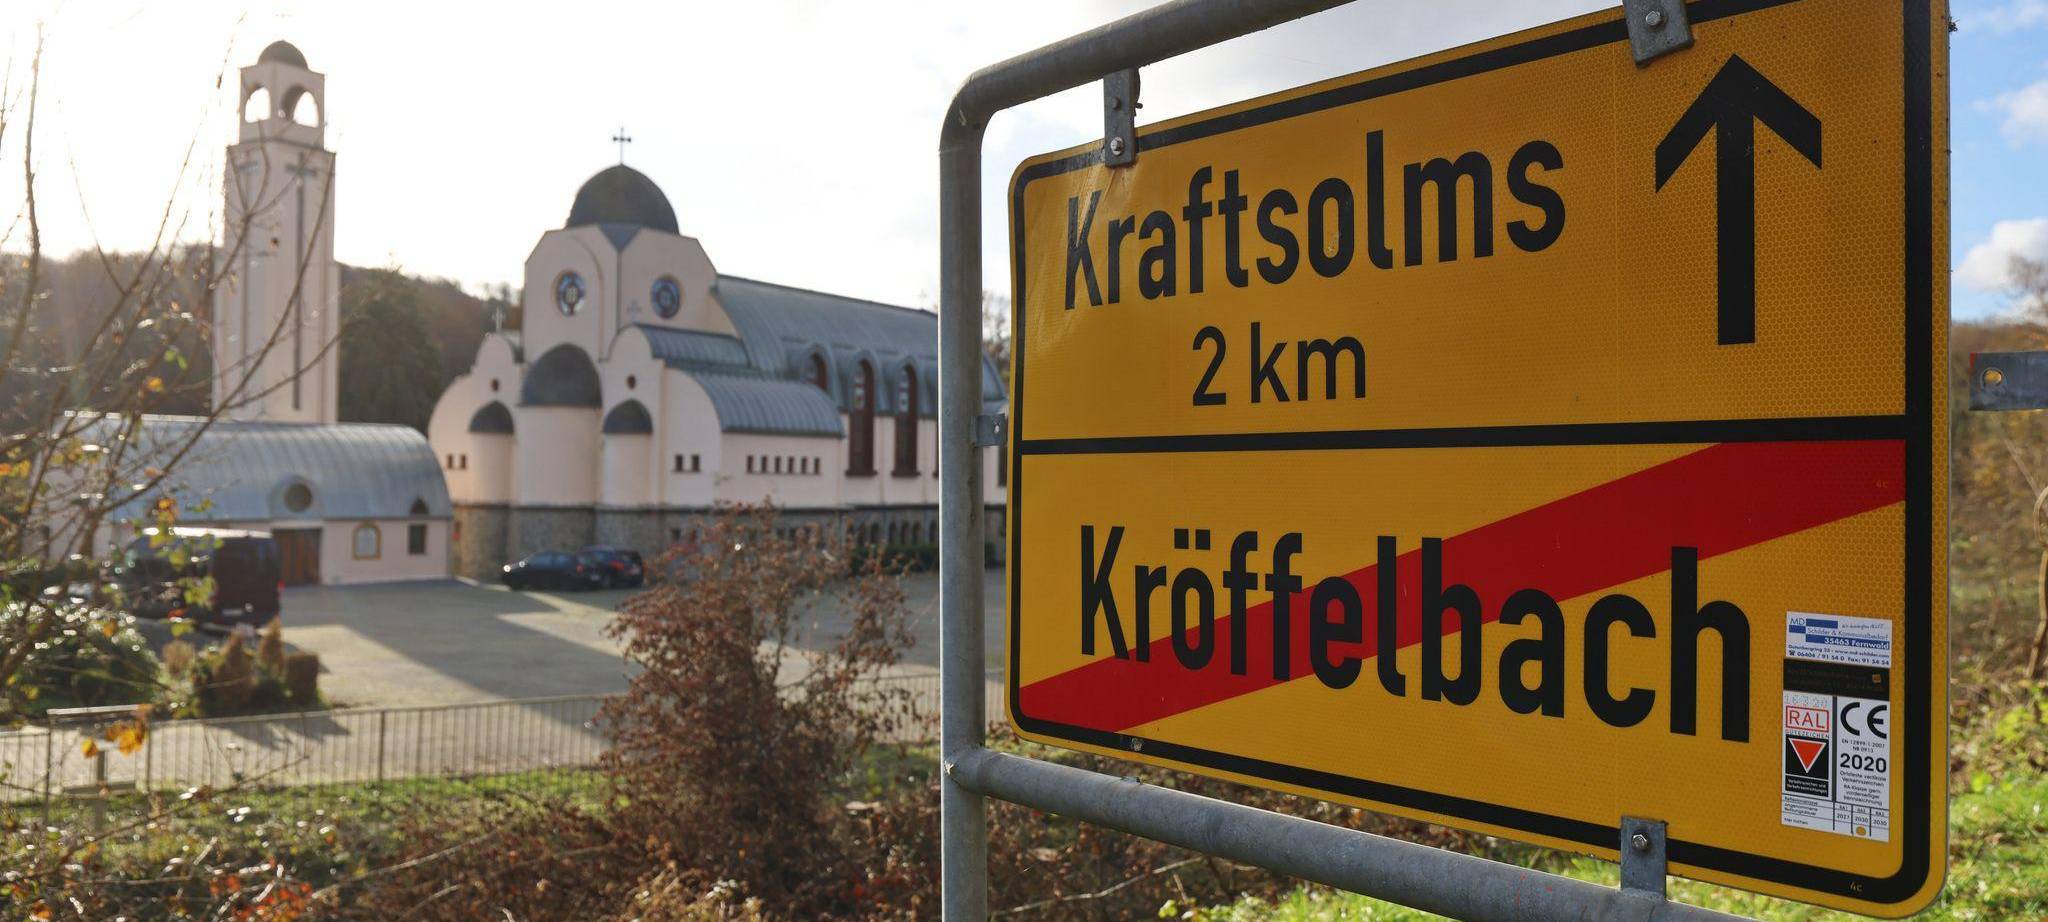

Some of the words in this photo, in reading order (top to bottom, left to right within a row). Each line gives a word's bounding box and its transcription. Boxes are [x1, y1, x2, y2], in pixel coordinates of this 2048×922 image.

[1064, 129, 1566, 310] Kraftsolms
[1193, 326, 1226, 406] 2
[1251, 322, 1365, 403] km
[1789, 617, 1805, 625] MD
[1080, 525, 1751, 743] Kröffelbach
[1807, 627, 1830, 636] Schilder
[1824, 637, 1850, 646] 35463
[1851, 639, 1890, 650] Fernwald
[1789, 710, 1826, 729] RAL
[1841, 702, 1887, 739] CE
[1840, 753, 1887, 772] 2020
